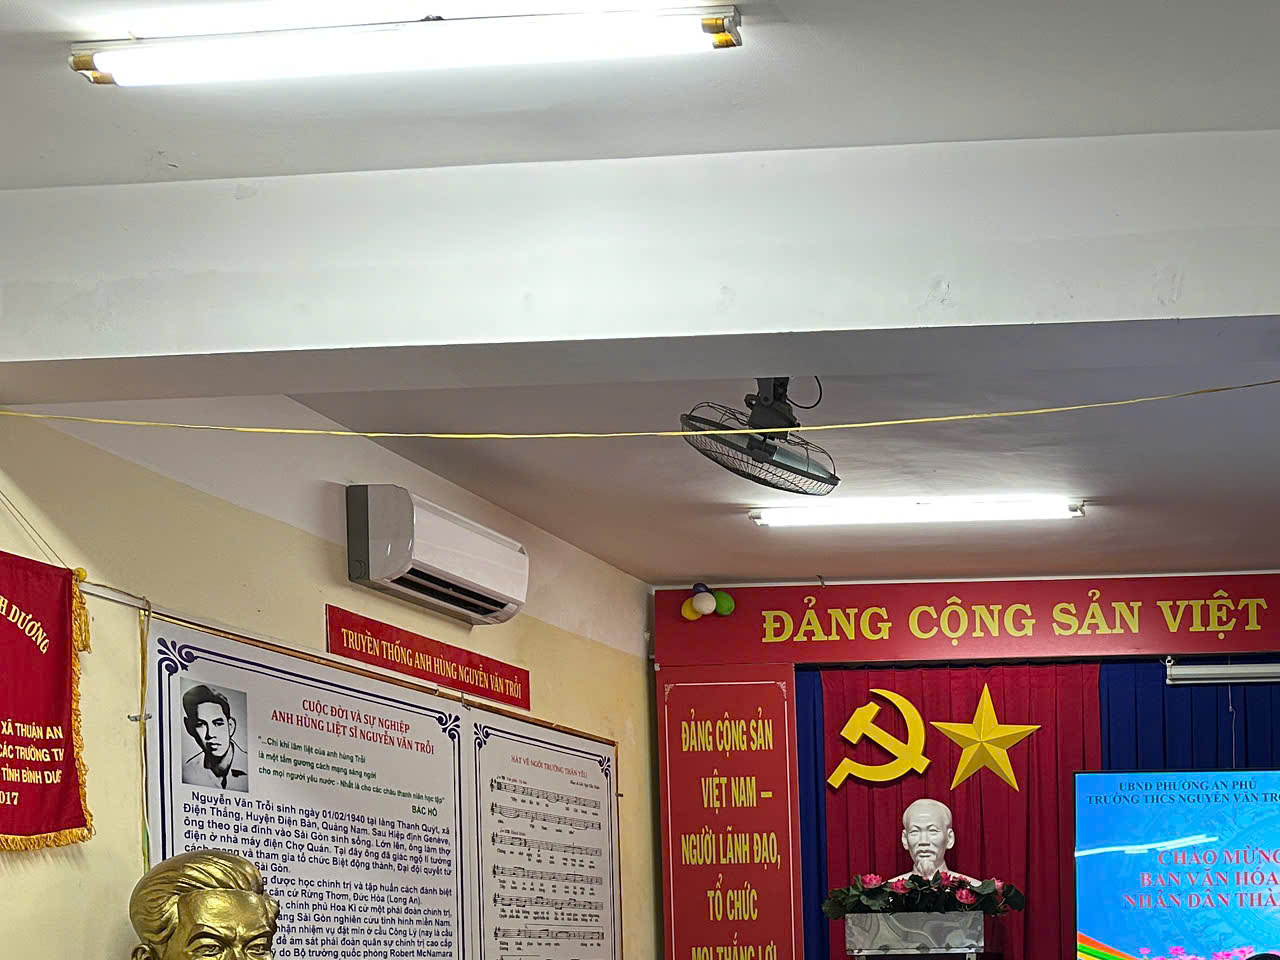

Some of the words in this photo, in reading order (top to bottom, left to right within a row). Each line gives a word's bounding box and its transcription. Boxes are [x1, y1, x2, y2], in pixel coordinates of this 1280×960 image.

[7, 606, 50, 655] DƯƠNG
[761, 595, 892, 643] ĐẢNG
[908, 596, 1036, 646] CỘNG
[1051, 588, 1143, 636] SẢN
[1156, 589, 1266, 640] VIỆT
[341, 628, 380, 657] TRUYỀN
[381, 640, 412, 667] THỐNG
[414, 652, 432, 673] ANH
[434, 655, 458, 680] HÙNG
[458, 664, 489, 689] NGUYỄN
[490, 672, 504, 694] VĂN
[505, 675, 522, 700] TRỖI
[1, 718, 14, 736] XÃ
[15, 721, 44, 741] THUẬN
[46, 726, 64, 740] AN
[272, 710, 294, 724] ANH
[296, 712, 324, 731] HÙNG
[326, 720, 346, 737] LIỆT
[349, 726, 358, 739] SĨ
[360, 729, 395, 747] NGUYỄN
[396, 737, 413, 751] VĂN
[414, 738, 434, 755] TRỖI
[302, 699, 329, 716] CUỘC
[330, 705, 348, 720] ĐỜI
[350, 709, 362, 723] VÀ
[364, 713, 376, 728] SỰ
[378, 717, 410, 735] NGHIỆP
[681, 709, 713, 753] ĐẢNG
[716, 712, 748, 758] CỘNG
[750, 707, 773, 752] SẢN
[15, 744, 51, 762] TRƯỜNG
[1, 764, 20, 783] TỈNH
[22, 767, 42, 784] BÌNH
[701, 769, 728, 814] VIỆT
[730, 776, 756, 808] NAM
[1119, 781, 1152, 792] UBND
[1156, 778, 1210, 791] PHƯỜNG
[1211, 780, 1230, 790] AN
[1232, 778, 1257, 790] PHÚ
[192, 791, 232, 806] Nguyễn
[234, 796, 253, 808] Văn
[256, 799, 274, 811] Trỗi
[276, 804, 296, 814] sinh
[298, 807, 320, 820] ngày
[322, 810, 366, 824] 01/02/1940
[367, 816, 377, 826] tại
[379, 816, 395, 830] làng
[397, 820, 420, 830] Thanh
[681, 829, 716, 865] NGƯỜI
[720, 826, 750, 865] LÃNH
[753, 832, 781, 870] ĐẠO,
[1158, 846, 1217, 865] CHÀO
[1140, 872, 1180, 886] BAN
[1186, 869, 1228, 886] VĂN
[1235, 867, 1279, 886] HÓA
[707, 873, 723, 921] TỔ
[726, 880, 758, 921] CHỨC
[1123, 890, 1181, 909] NHÂN
[1188, 889, 1229, 908] DÂN
